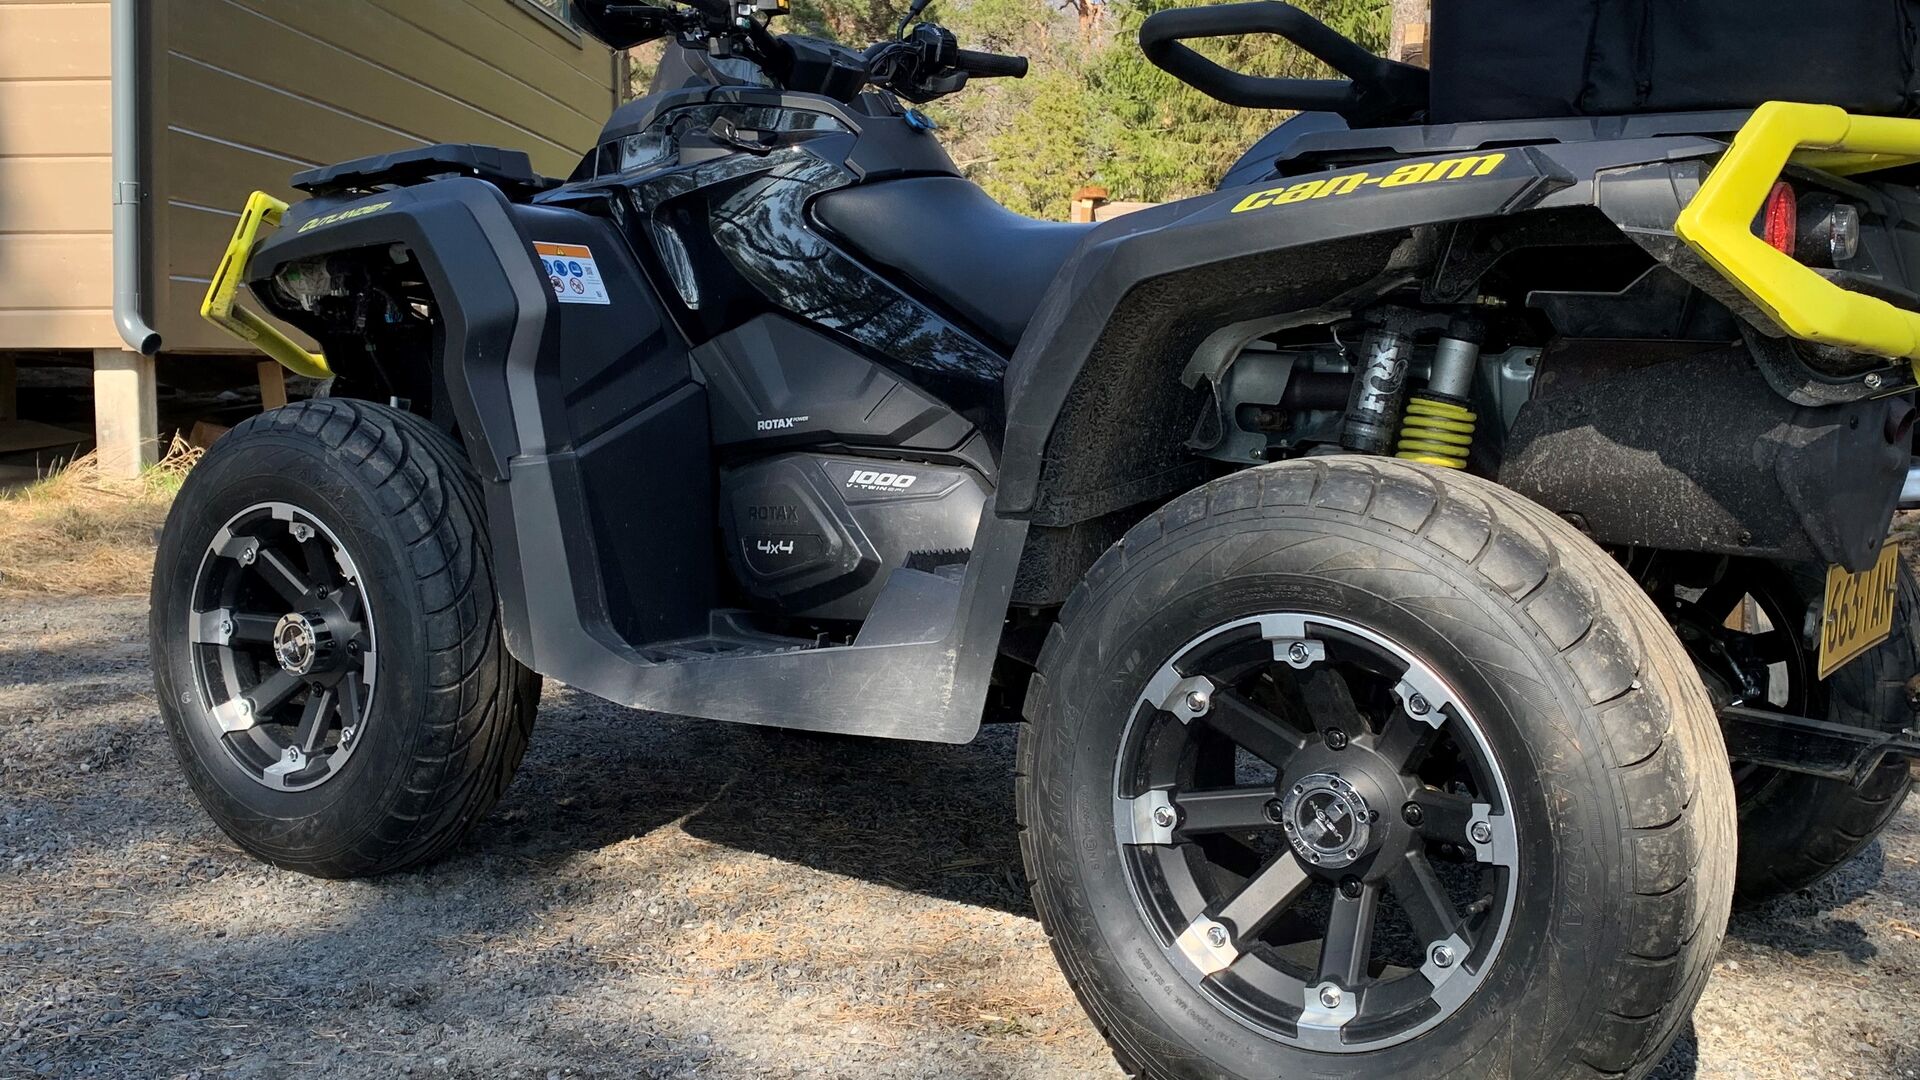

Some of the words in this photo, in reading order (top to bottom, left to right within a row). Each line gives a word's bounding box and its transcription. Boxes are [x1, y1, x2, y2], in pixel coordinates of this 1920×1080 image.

[1231, 153, 1506, 214] can-am
[297, 201, 392, 234] OUTLANDER
[757, 417, 794, 431] ROTAX
[847, 470, 917, 488] 1000
[748, 505, 799, 520] ROTAX
